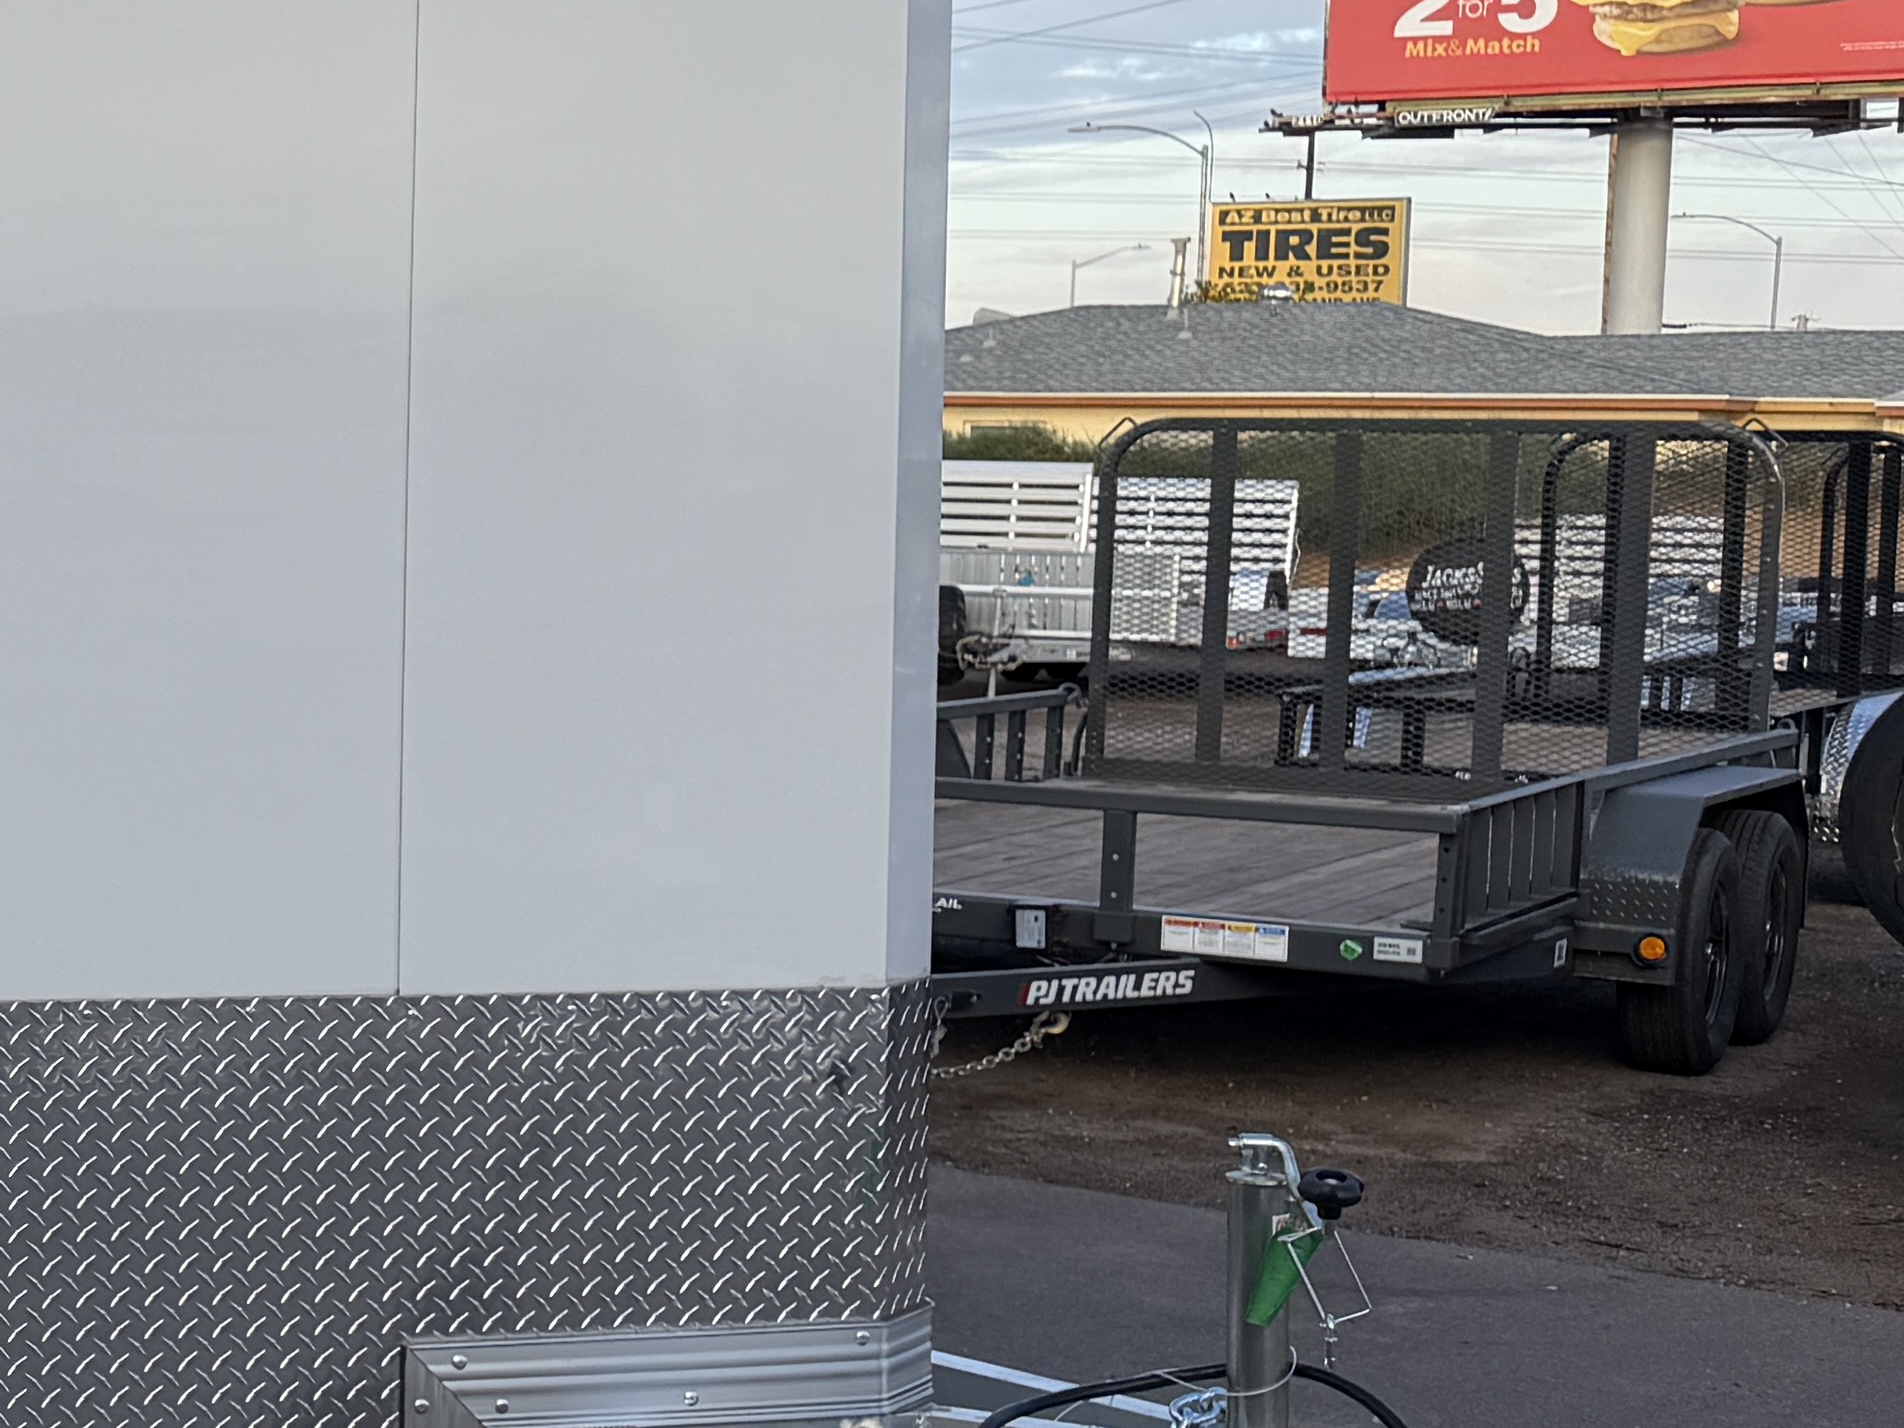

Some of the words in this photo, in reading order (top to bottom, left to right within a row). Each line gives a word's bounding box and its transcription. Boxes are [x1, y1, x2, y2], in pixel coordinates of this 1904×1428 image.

[1225, 210, 1254, 223] AZ
[1261, 209, 1311, 222] Best
[1318, 207, 1361, 222] Tire
[1365, 209, 1391, 221] LLC
[1221, 227, 1390, 262] TIRES
[1218, 265, 1277, 279] NEW
[1286, 265, 1304, 278] &
[1316, 263, 1390, 278] USED
[1061, 969, 1195, 1004] TRAILERS
